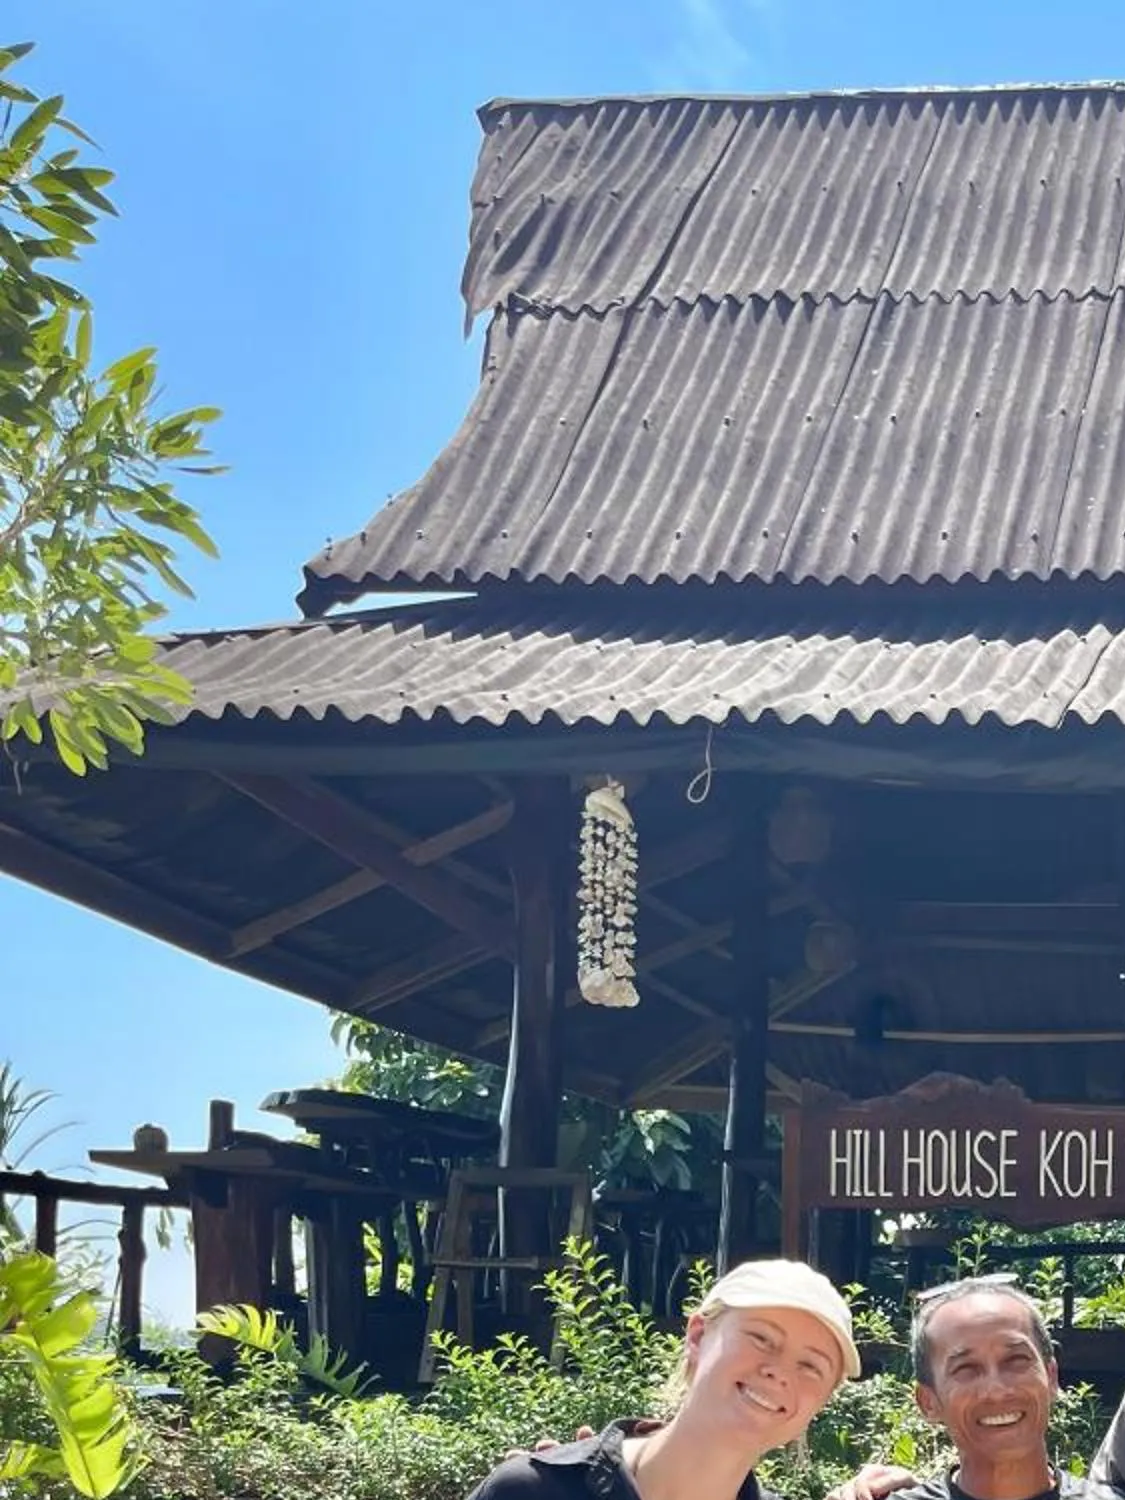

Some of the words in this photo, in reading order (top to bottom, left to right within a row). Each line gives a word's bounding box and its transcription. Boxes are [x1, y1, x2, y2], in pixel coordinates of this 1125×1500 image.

[830, 1129, 893, 1198] HILL
[903, 1129, 1018, 1199] HOUSE
[1040, 1129, 1113, 1198] KOH
